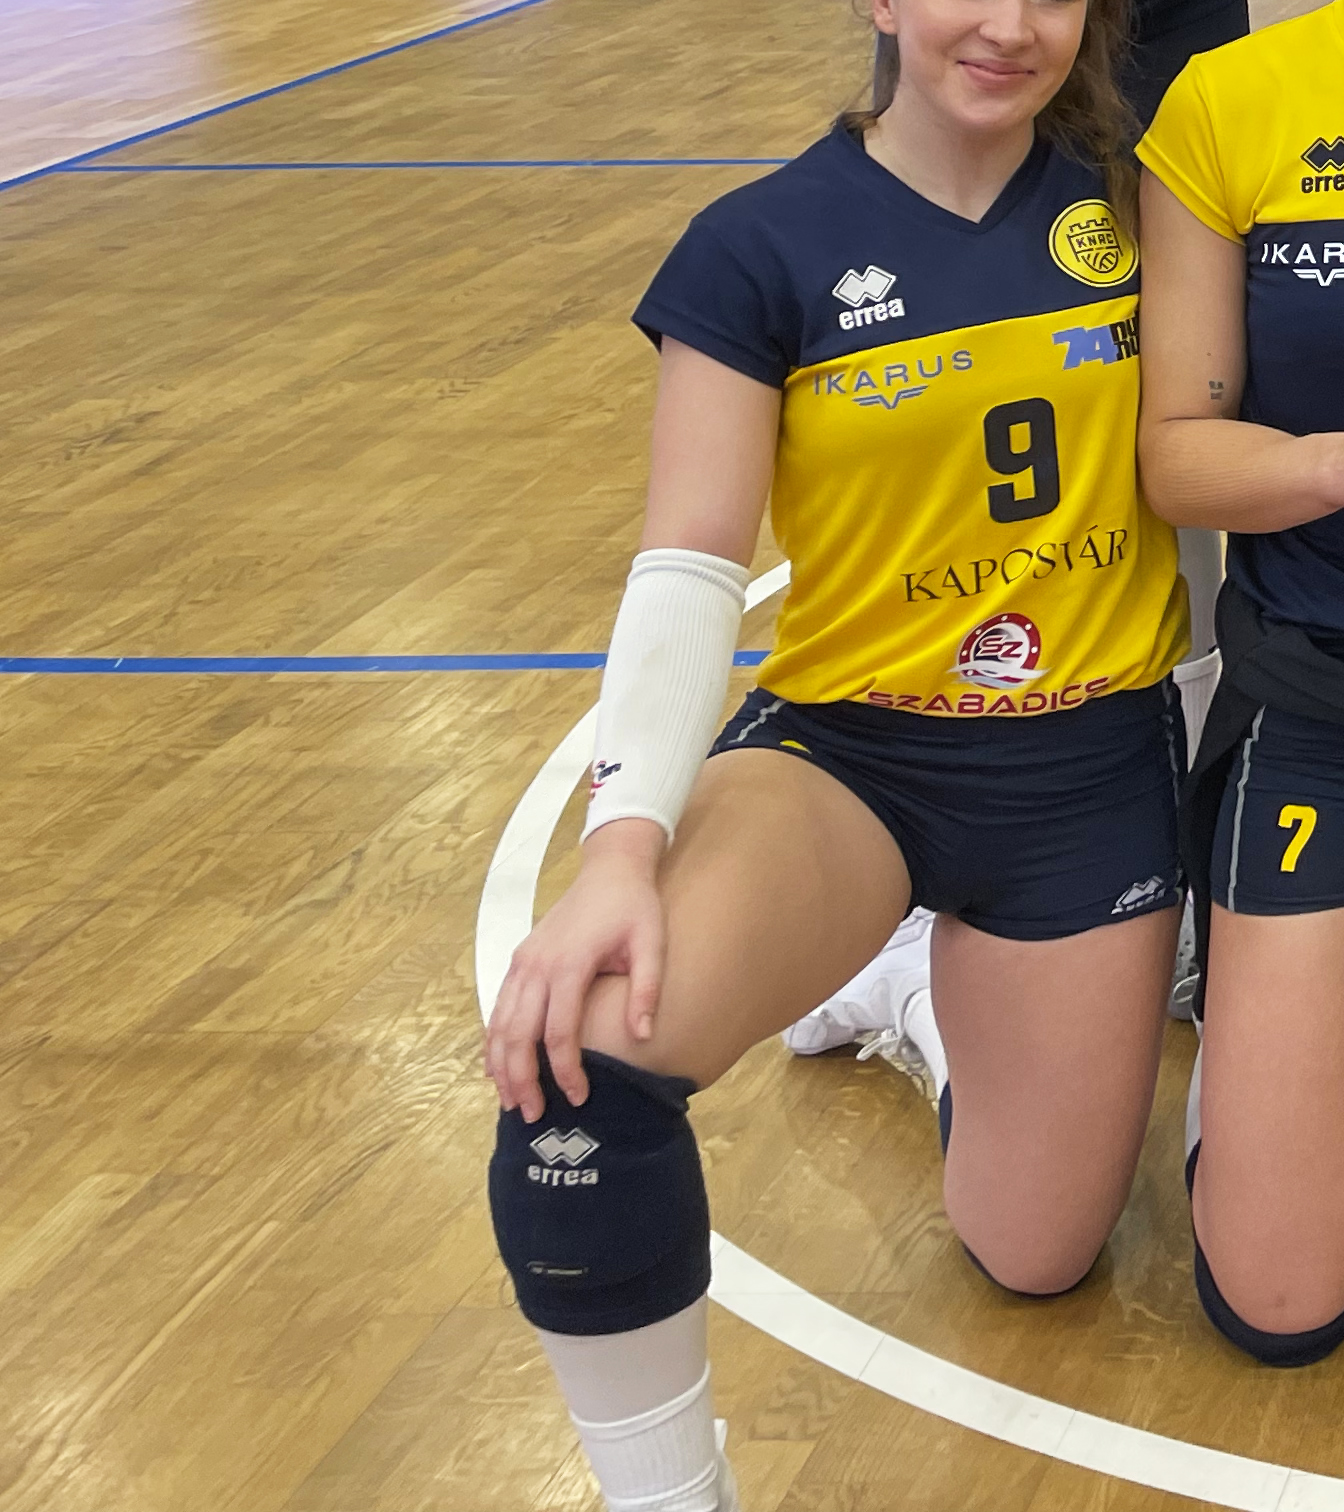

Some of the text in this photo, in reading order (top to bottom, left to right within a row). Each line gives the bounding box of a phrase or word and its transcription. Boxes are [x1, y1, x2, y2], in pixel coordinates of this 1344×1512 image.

[1075, 232, 1114, 249] KNRC
[838, 297, 906, 331] errea
[812, 349, 974, 396] IKARUS
[983, 397, 1061, 524] 9
[867, 676, 1111, 715] SZABADICS
[1277, 804, 1318, 873] 7
[527, 1162, 600, 1187] errea
